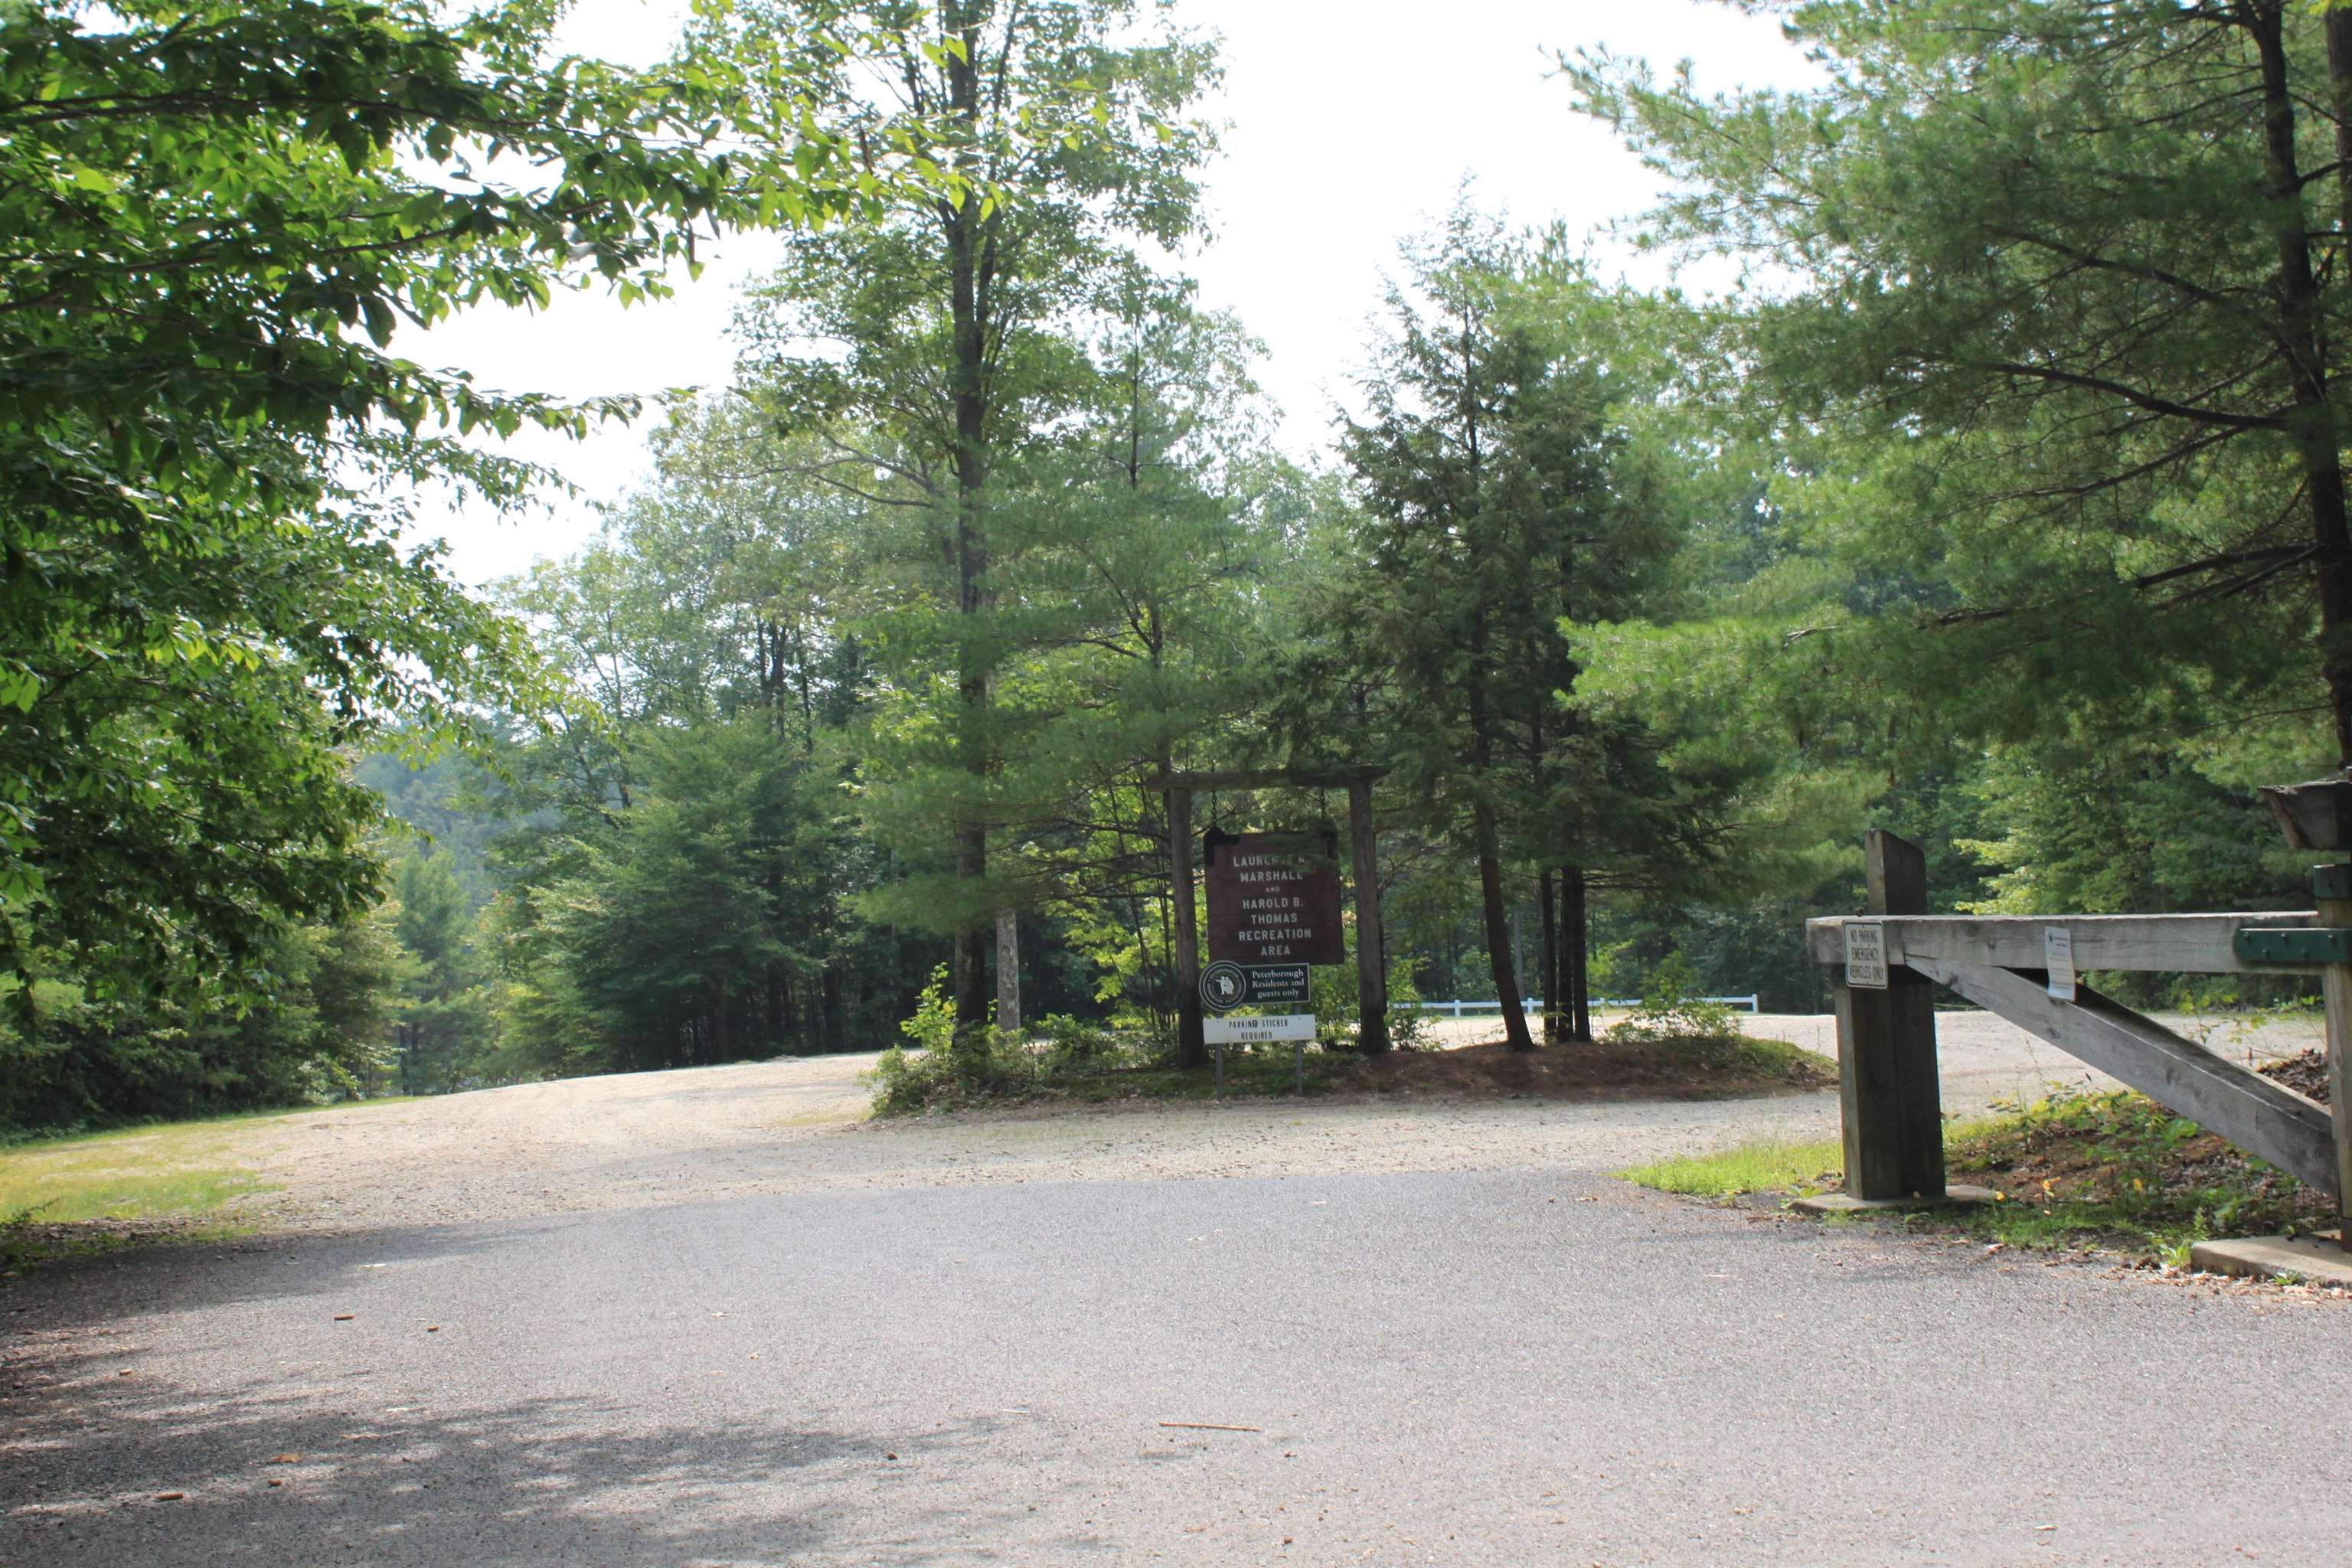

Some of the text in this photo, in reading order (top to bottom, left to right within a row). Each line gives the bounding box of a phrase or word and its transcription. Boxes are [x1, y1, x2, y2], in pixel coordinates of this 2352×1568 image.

[1240, 870, 1303, 882] MARSHALL
[1243, 897, 1304, 910] HAROLD B.
[1250, 913, 1298, 925] THOMAS
[1238, 927, 1312, 941] RECREATION
[1260, 944, 1291, 956] AREA
[1851, 947, 1879, 961] EMERGENCY
[1252, 969, 1304, 979] Peterborough
[1252, 978, 1305, 988] Residents and
[1256, 988, 1301, 999] guests only
[1229, 1018, 1288, 1029] PARKING STICKER
[1240, 1031, 1272, 1040] REQUIRED
